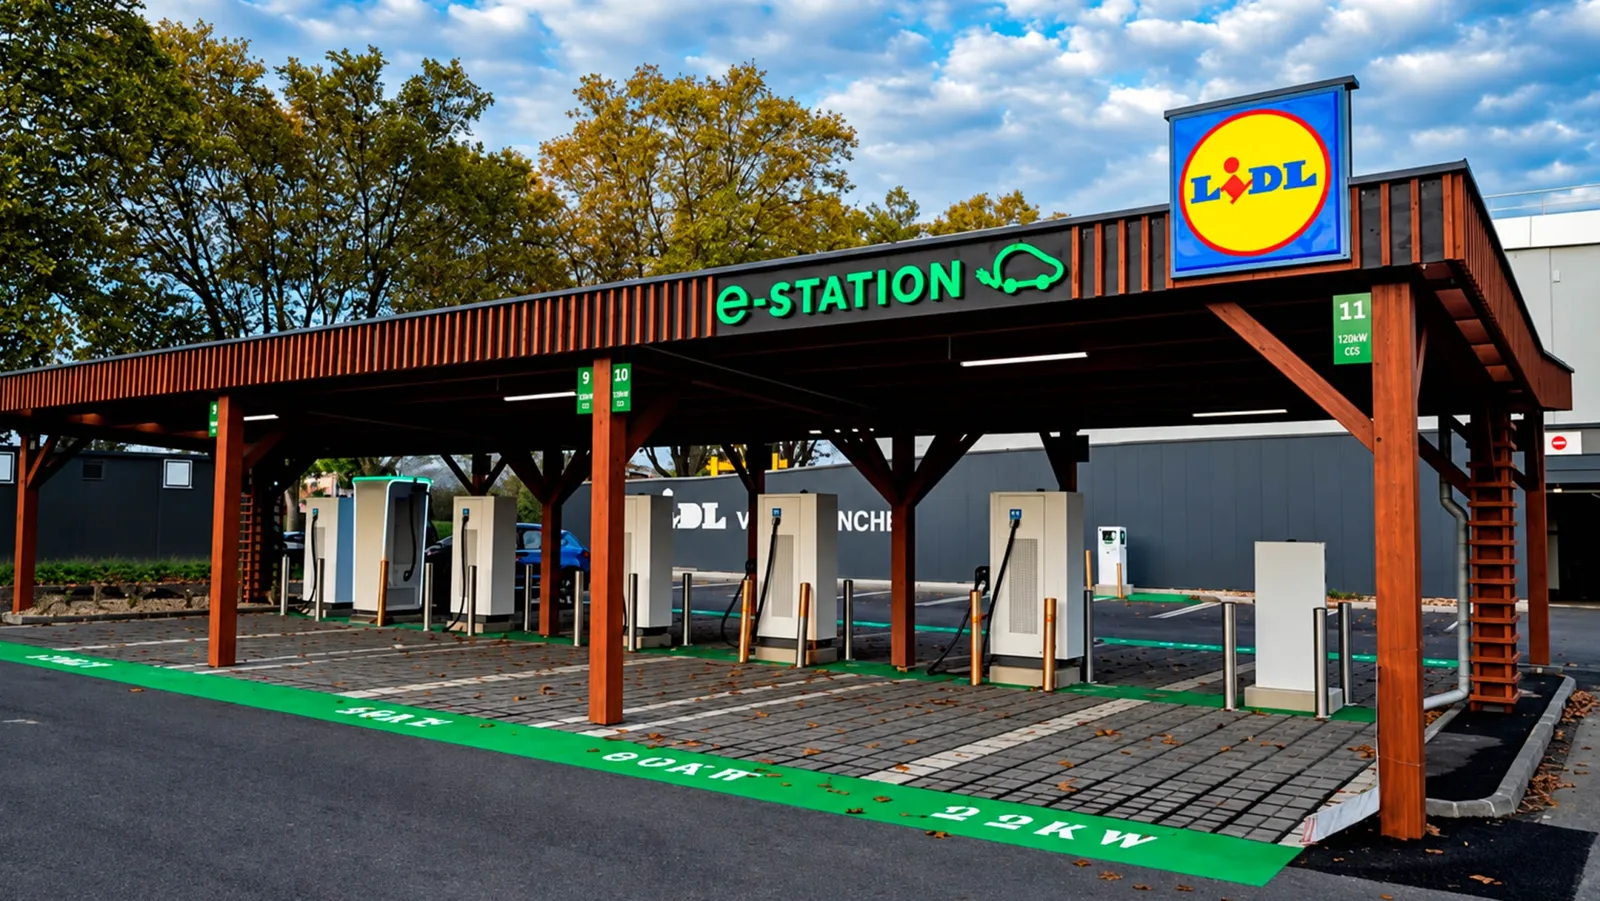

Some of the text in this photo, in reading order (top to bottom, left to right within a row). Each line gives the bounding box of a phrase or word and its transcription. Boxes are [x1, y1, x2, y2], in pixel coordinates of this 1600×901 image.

[716, 260, 961, 325] e-STATION
[1339, 300, 1366, 320] 11
[1338, 333, 1368, 344] 120kW
[1344, 346, 1360, 356] CCS
[582, 371, 590, 384] 9
[614, 368, 628, 382] 10
[930, 806, 1158, 848] 22KW
